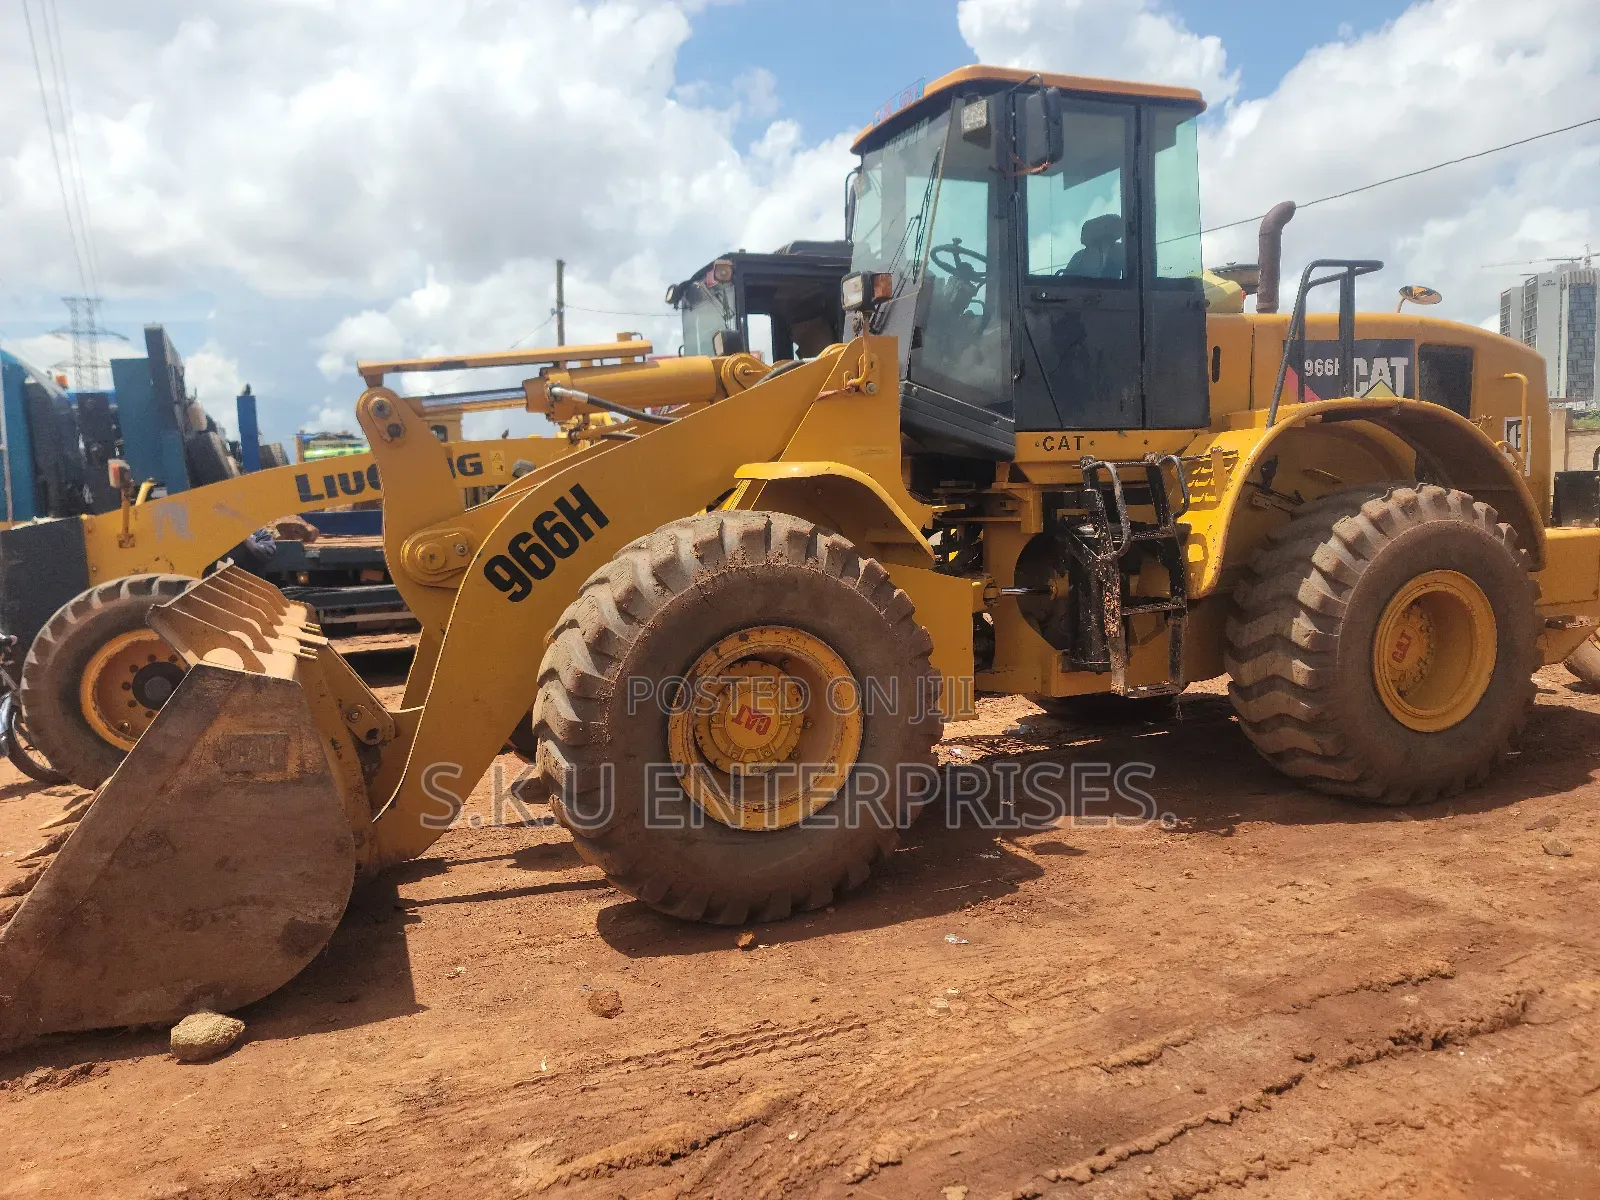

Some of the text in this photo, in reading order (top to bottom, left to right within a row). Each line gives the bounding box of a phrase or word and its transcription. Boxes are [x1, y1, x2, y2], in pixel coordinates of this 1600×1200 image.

[1353, 356, 1409, 398] CAT
[1042, 435, 1085, 451] CAT
[483, 482, 611, 603] 966H
[1391, 629, 1413, 664] CAT
[730, 703, 772, 736] CAT
